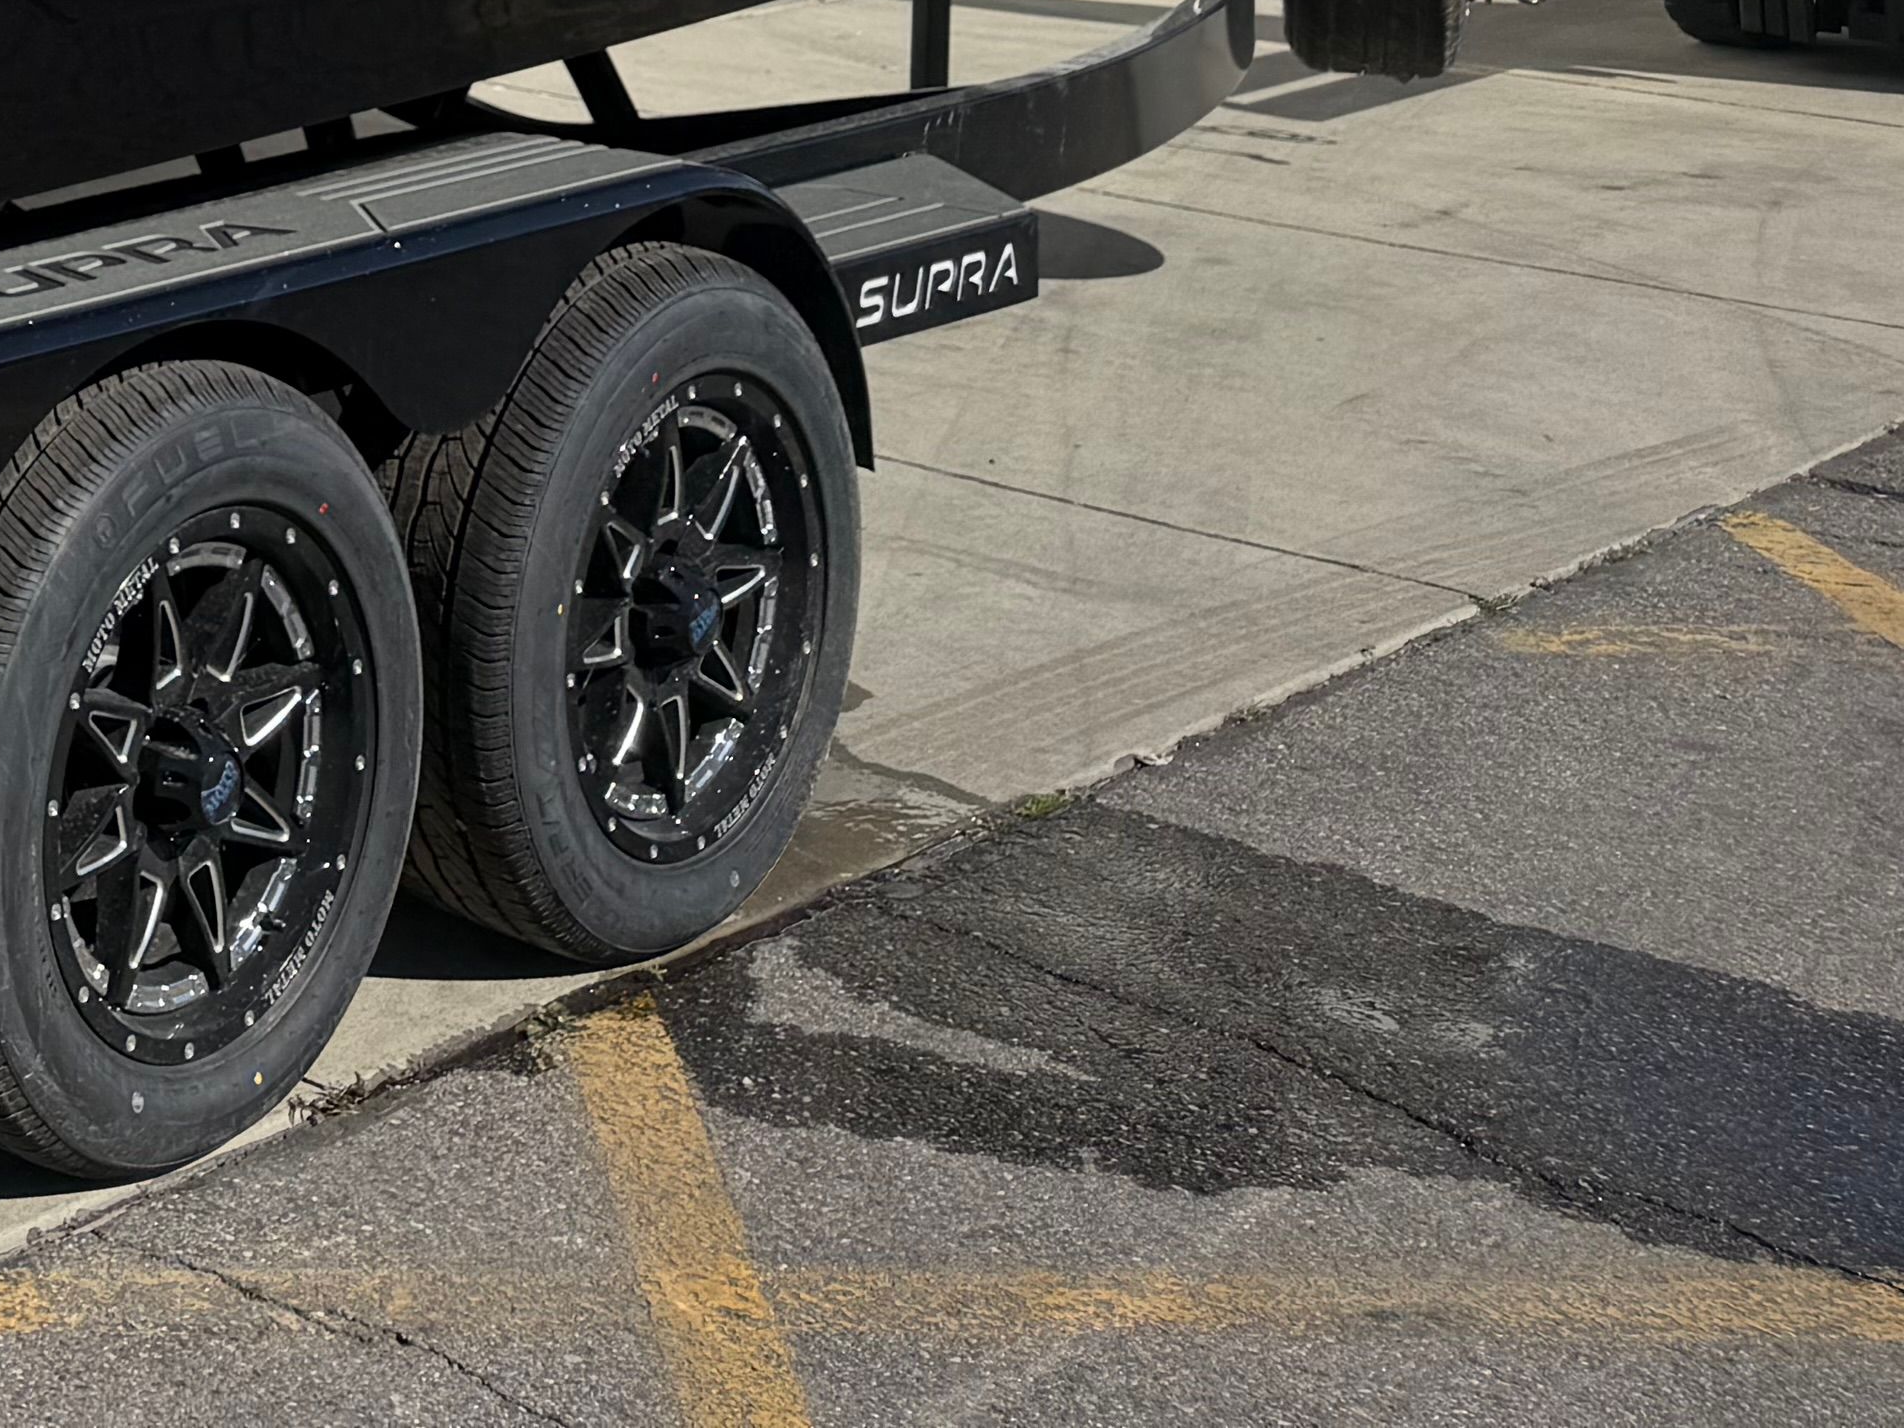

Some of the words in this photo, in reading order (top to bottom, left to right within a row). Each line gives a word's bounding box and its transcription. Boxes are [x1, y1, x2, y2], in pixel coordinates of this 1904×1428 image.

[855, 241, 1020, 329] SUPRA
[81, 611, 116, 673] MOTO
[304, 888, 335, 946] MOTO
[264, 946, 307, 1005] METAL
